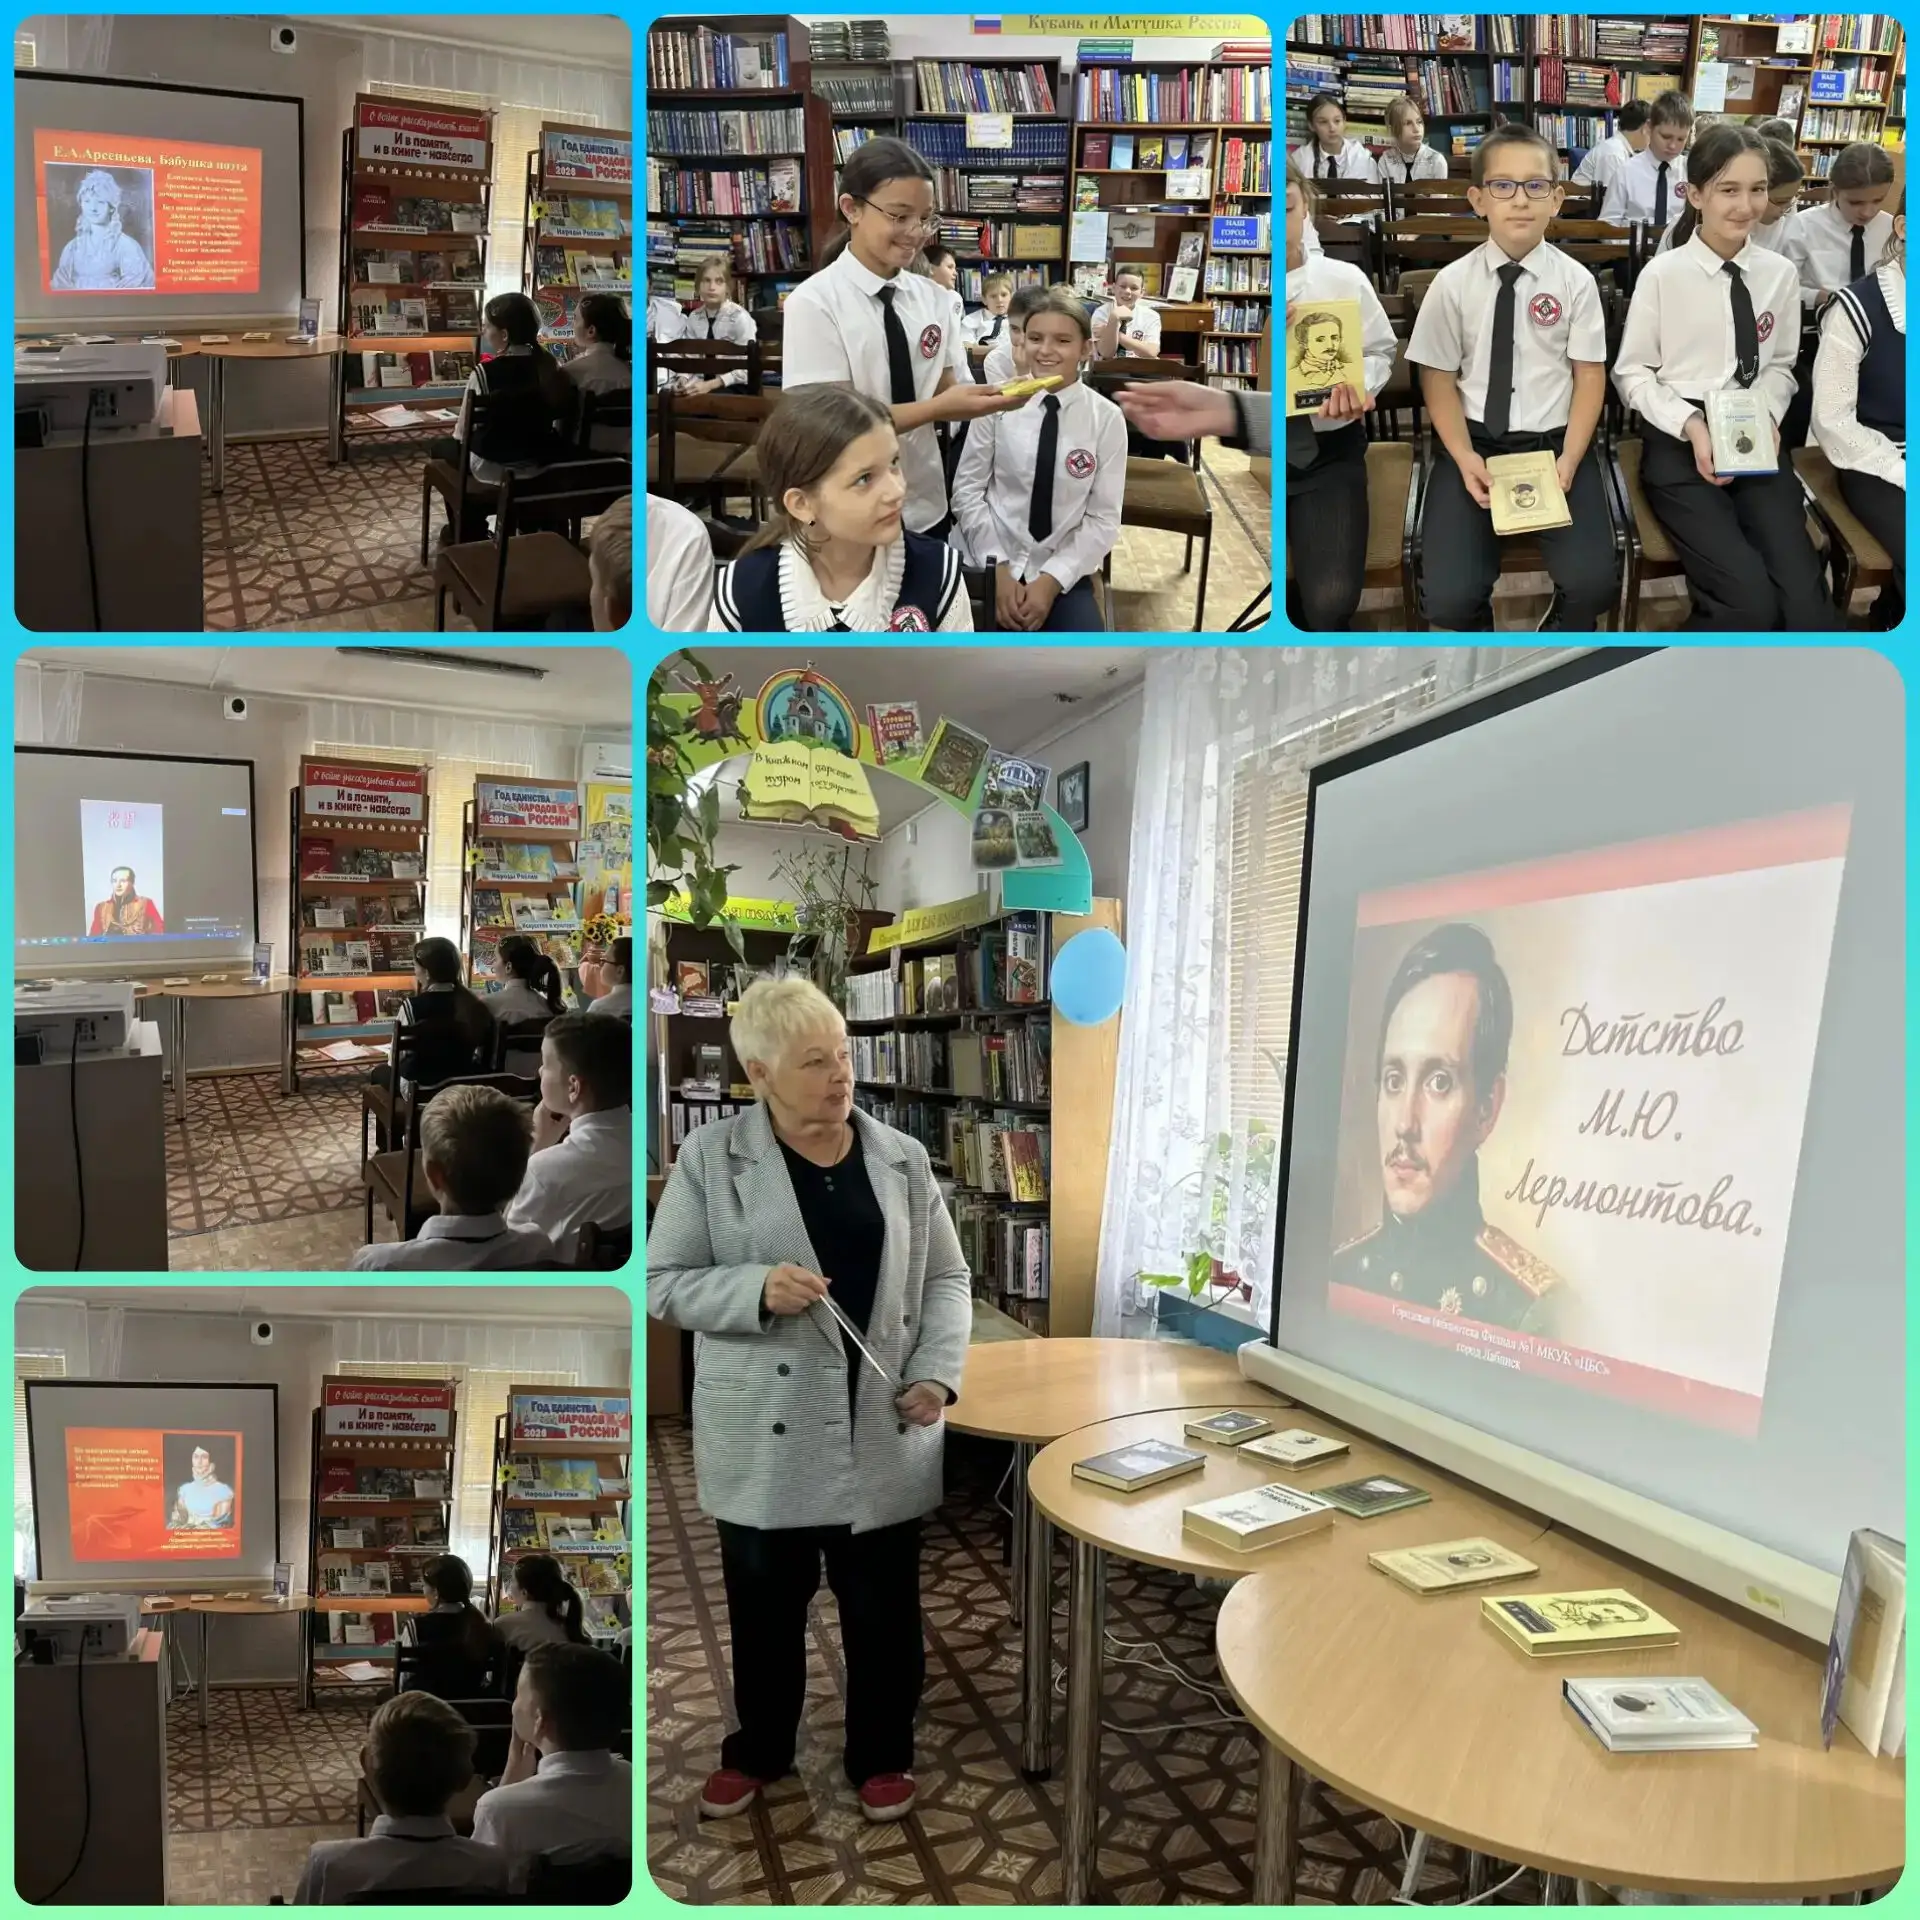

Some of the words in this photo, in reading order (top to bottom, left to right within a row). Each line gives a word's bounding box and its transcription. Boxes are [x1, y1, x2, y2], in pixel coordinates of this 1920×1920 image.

[1027, 15, 1084, 34] Кубань
[1089, 19, 1098, 29] и
[1103, 15, 1182, 35] Матушка
[1187, 15, 1242, 30] Россия
[394, 132, 403, 145] И
[405, 136, 411, 146] в
[413, 137, 453, 151] памяти,
[580, 142, 619, 155] ЕДИНСТВА
[373, 145, 381, 153] и
[383, 146, 389, 154] в
[391, 147, 422, 158] книге
[429, 151, 473, 164] навсегда
[585, 153, 625, 165] НАРОДОВ
[159, 154, 213, 171] Бабушка
[216, 161, 248, 172] поэта
[1226, 219, 1245, 227] НАШ
[1232, 238, 1257, 246] ДОРОГ
[755, 752, 763, 762] В
[765, 755, 808, 770] книжном
[765, 775, 801, 787] мудром
[337, 789, 345, 801] И
[347, 793, 353, 801] в
[354, 793, 392, 806] памяти,
[512, 792, 550, 803] ЕДИНСТВА
[318, 801, 325, 809] и
[327, 801, 333, 810] в
[334, 802, 362, 812] книге
[369, 804, 411, 816] навсегда
[518, 802, 557, 815] НАРОДОВ
[528, 814, 570, 826] РОССИИ
[1560, 996, 1744, 1057] Детство
[1578, 1088, 1682, 1141] М.Ю.
[1504, 1158, 1762, 1237] Лермонтова.
[1456, 1342, 1482, 1360] город
[1484, 1347, 1521, 1370] Лабинск
[1481, 1327, 1517, 1349] Филиал
[1520, 1336, 1534, 1354] №1
[1537, 1346, 1572, 1367] МКУК
[1574, 1355, 1611, 1375] «ЦБС»
[358, 1408, 367, 1420] И
[369, 1411, 374, 1420] в
[376, 1411, 416, 1422] памяти,
[551, 1403, 597, 1413] ЕДИНСТВА
[558, 1414, 605, 1424] НАРОДОВ
[339, 1421, 346, 1429] и
[347, 1421, 354, 1430] в
[355, 1421, 384, 1431] книге
[392, 1423, 436, 1433] навсегда
[570, 1425, 620, 1438] РОССИИ
